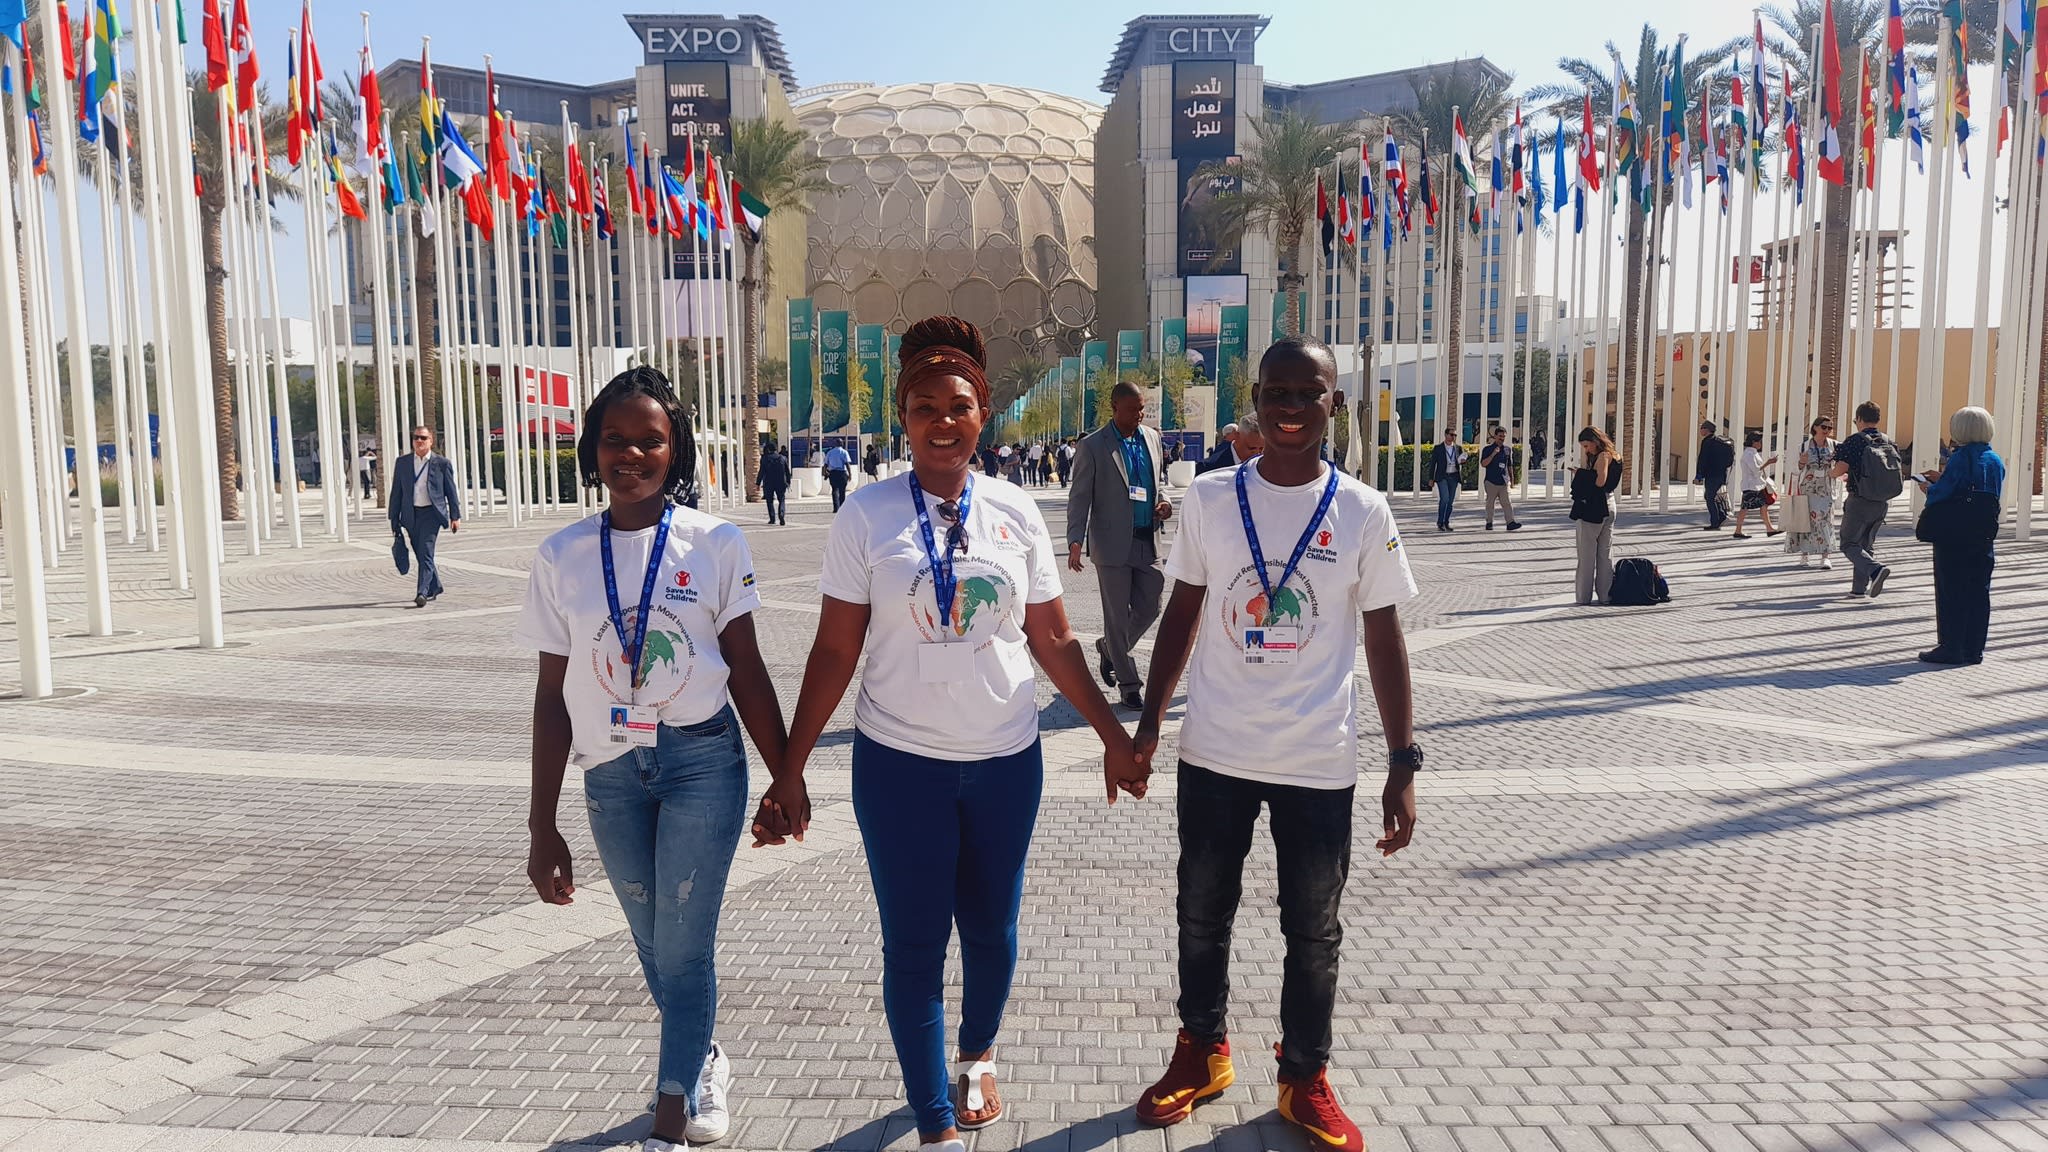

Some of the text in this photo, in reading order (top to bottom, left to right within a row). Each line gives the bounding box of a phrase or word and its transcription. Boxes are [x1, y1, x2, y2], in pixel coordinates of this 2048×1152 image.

[646, 27, 743, 54] EXPO
[1168, 27, 1242, 53] CITY
[669, 84, 709, 97] UNITE.
[671, 103, 698, 117] ACT.
[823, 363, 840, 375] UAE
[1306, 545, 1324, 555] Save
[1305, 552, 1337, 563] Children
[907, 575, 922, 597] Least
[970, 555, 994, 567] Most
[993, 562, 1018, 598] Impacted:
[665, 586, 698, 597] Save the
[665, 593, 698, 603] Children
[1227, 572, 1242, 591] Least
[1304, 578, 1320, 619] Impacted:
[593, 620, 611, 642] Least
[656, 604, 678, 622] Most
[675, 619, 697, 658] Impacted:
[669, 681, 688, 700] Climate
